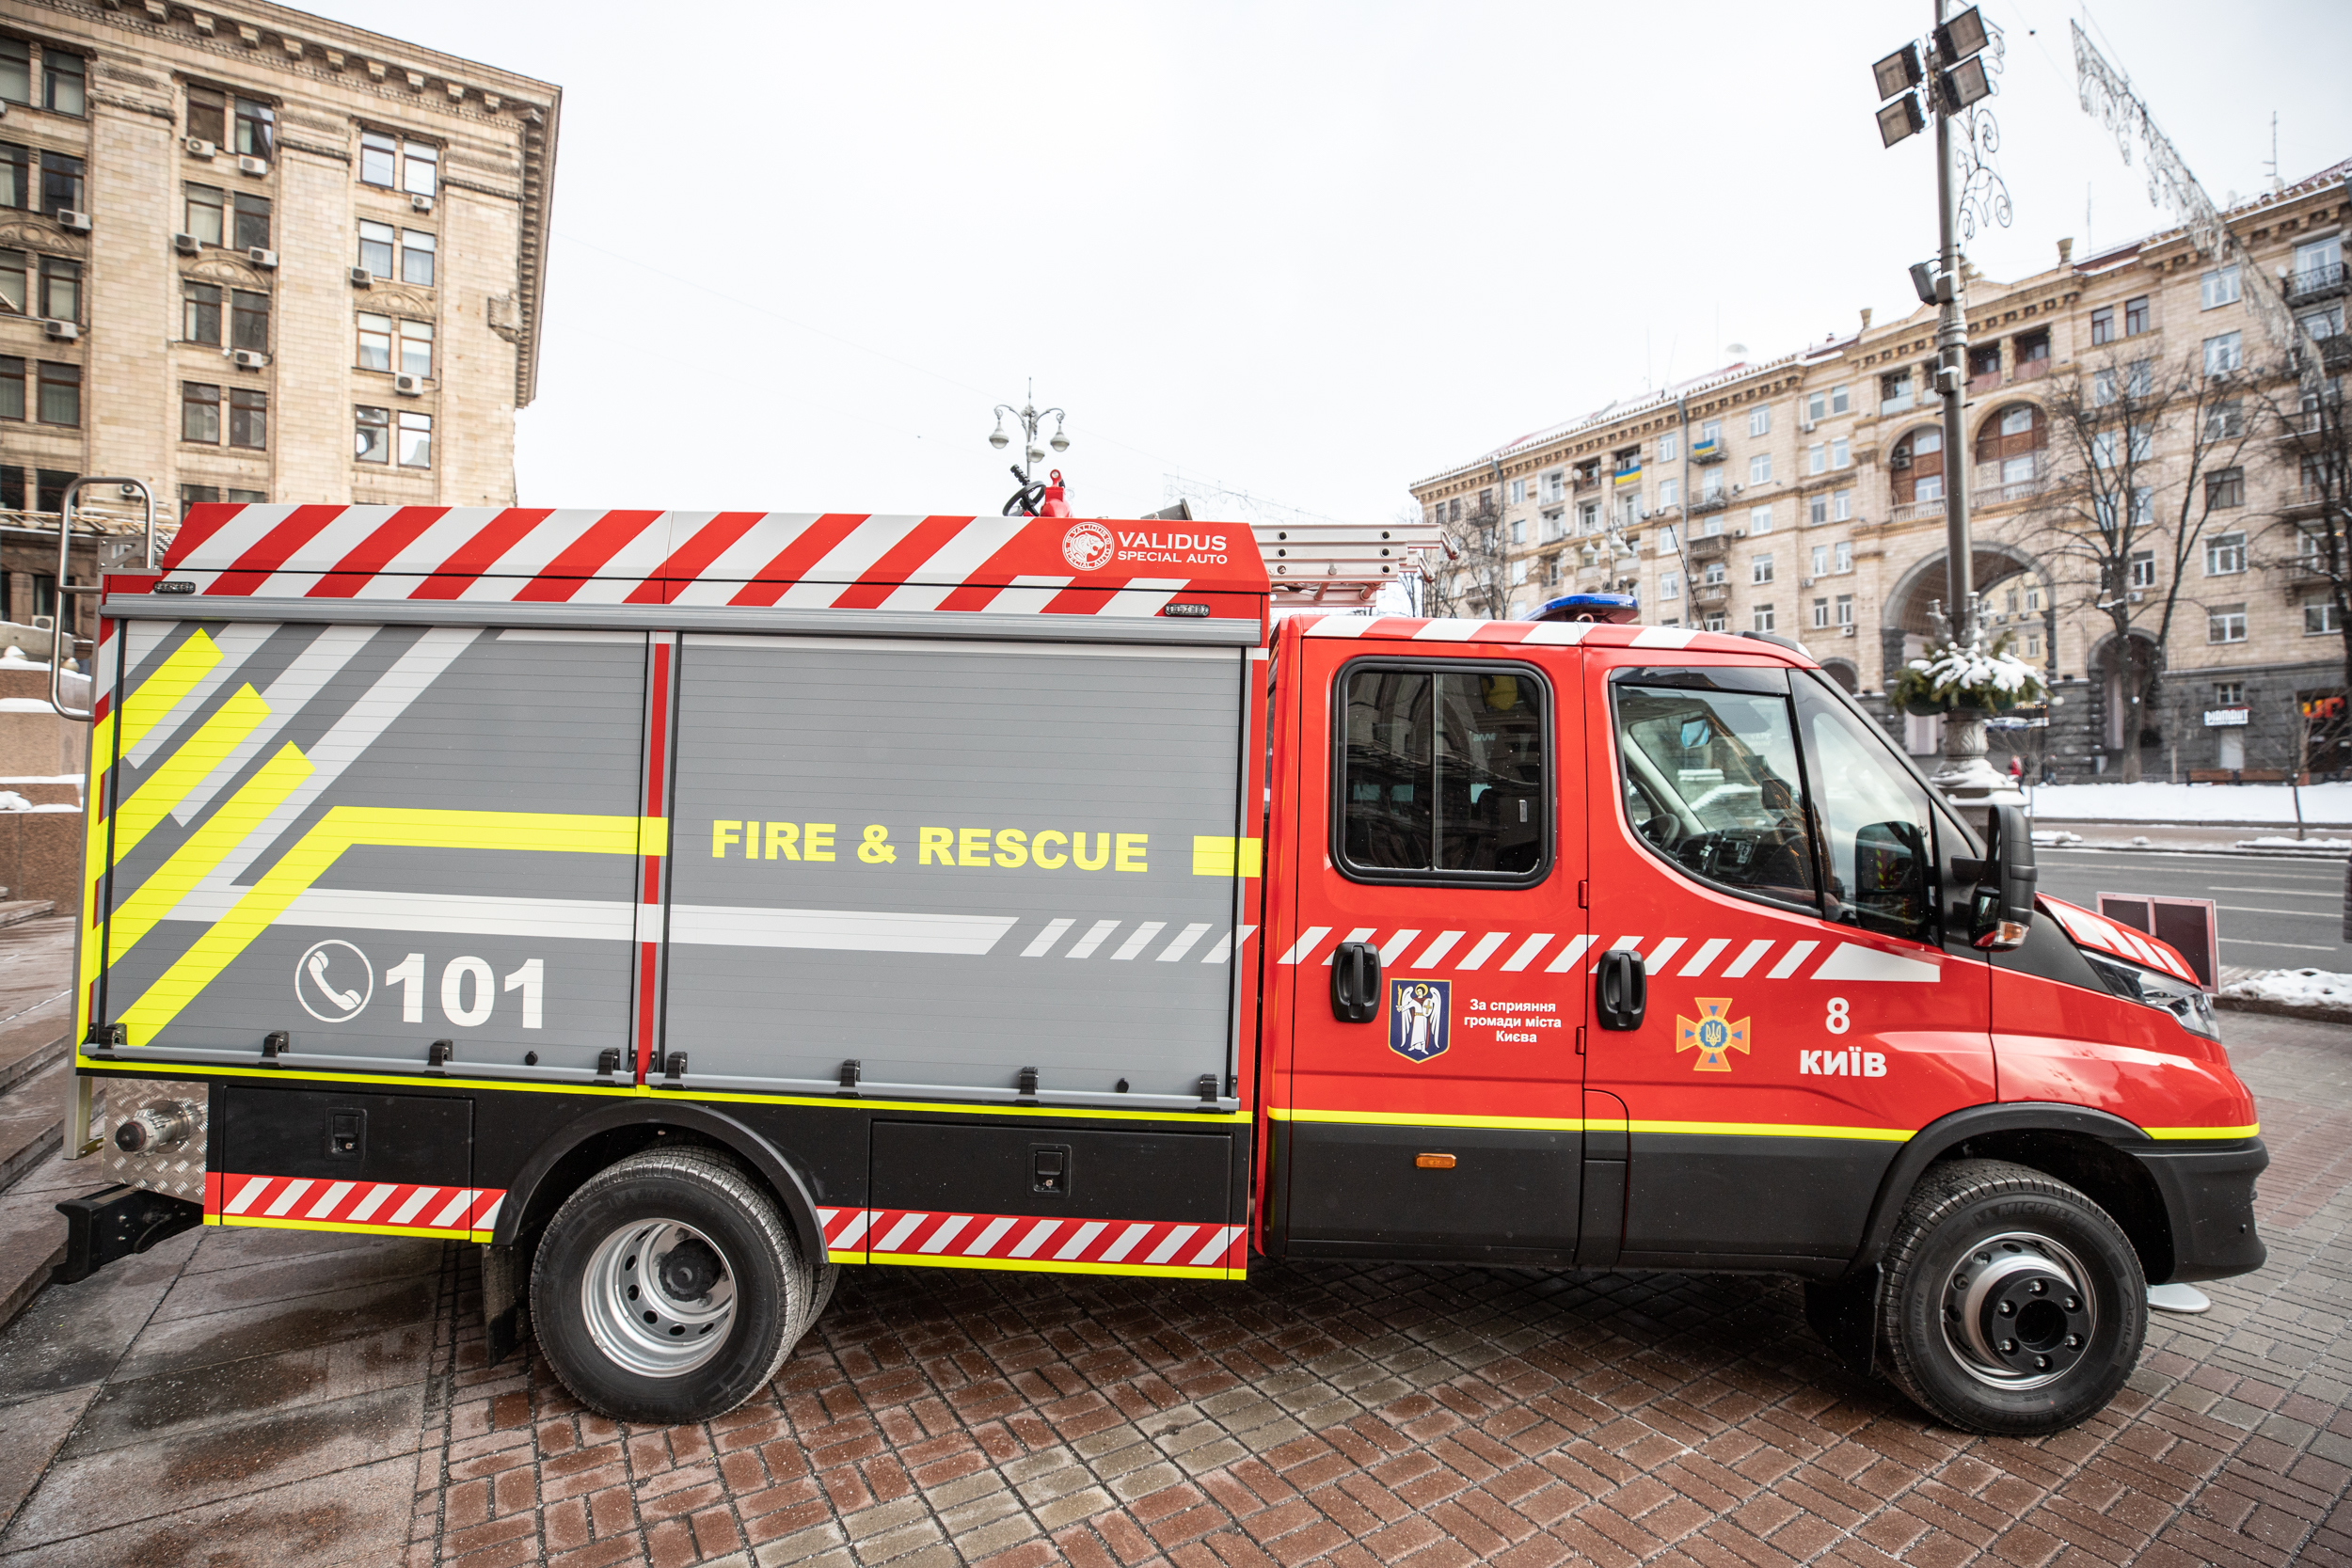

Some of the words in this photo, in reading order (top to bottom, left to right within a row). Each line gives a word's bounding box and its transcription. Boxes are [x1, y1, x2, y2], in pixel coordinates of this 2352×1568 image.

[1071, 524, 1107, 536] VALIDUS
[1117, 531, 1227, 551] VALIDUS
[1066, 546, 1094, 568] SPECIAL
[1095, 548, 1110, 566] AUTO
[1117, 550, 1182, 563] SPECIAL
[1185, 553, 1228, 564] AUTO
[711, 820, 836, 863] FIRE
[856, 824, 898, 864] &
[918, 826, 1149, 873] RESCUE
[385, 953, 544, 1029] 101
[1470, 998, 1486, 1011] За
[1489, 1001, 1556, 1016] сприяння
[1825, 997, 1851, 1035] 8
[1464, 1016, 1521, 1030] громади
[1525, 1015, 1562, 1028] міста
[1496, 1030, 1537, 1043] Києва
[1800, 1045, 1887, 1078] КИЇВ
